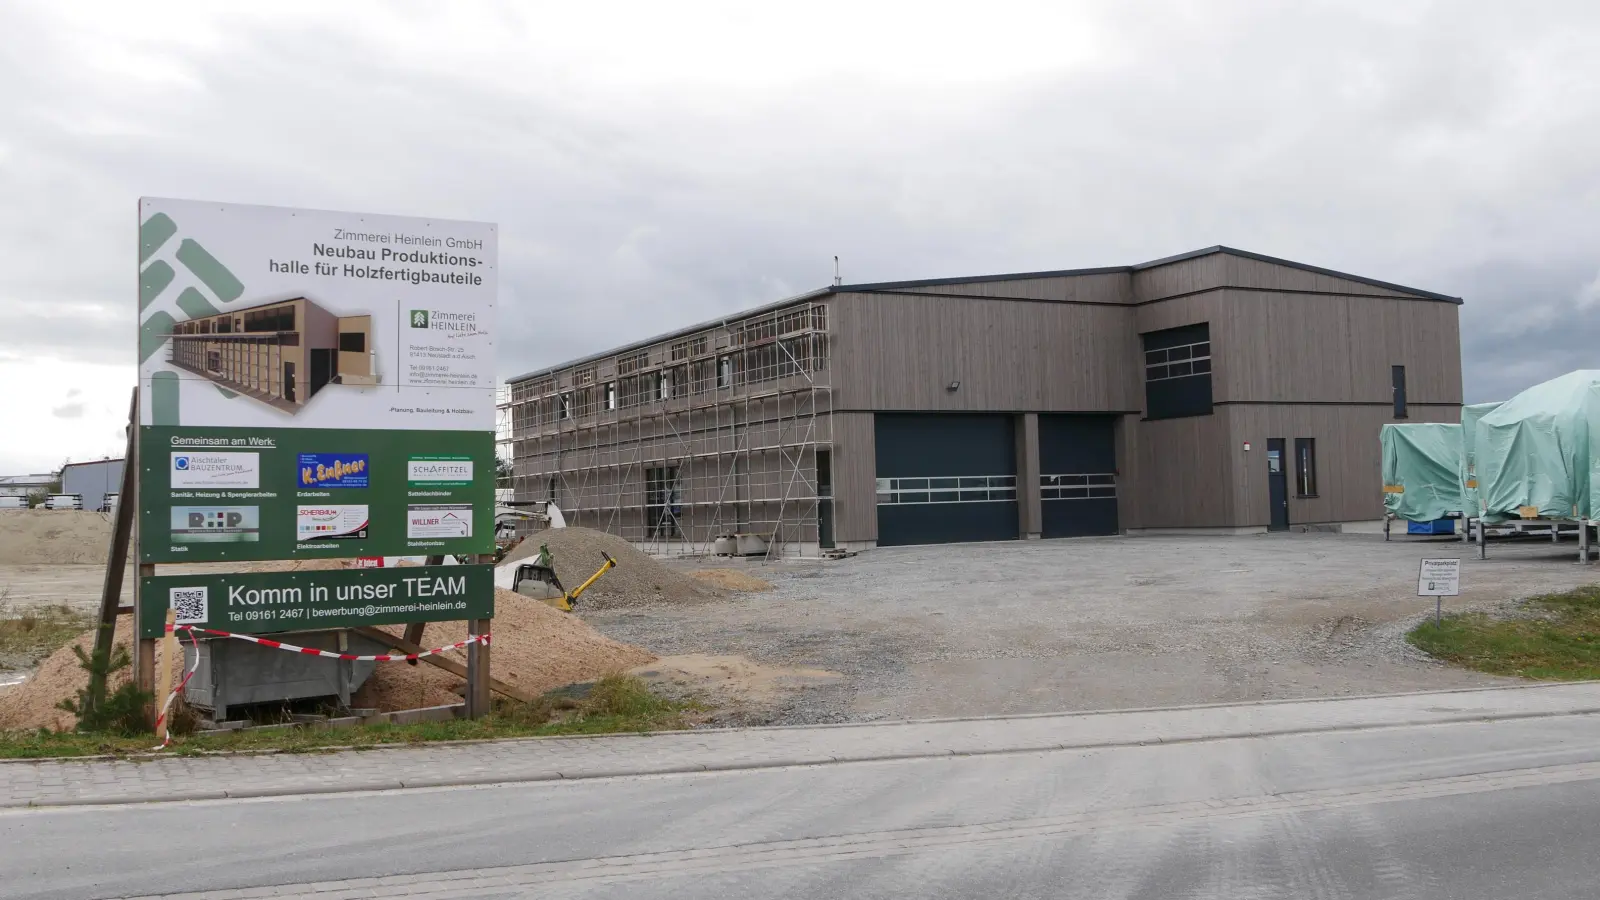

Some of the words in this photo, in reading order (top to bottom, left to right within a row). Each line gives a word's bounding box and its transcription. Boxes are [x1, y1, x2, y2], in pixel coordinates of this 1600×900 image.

[334, 228, 391, 244] Zimmerei
[394, 234, 442, 248] Heinlein
[446, 237, 483, 250] GmbH
[313, 243, 376, 260] Neubau
[381, 248, 483, 267] Produktions-
[269, 259, 309, 275] halle
[315, 262, 338, 277] für
[343, 264, 482, 286] Holzfertigbauteile
[431, 310, 476, 321] Zimmerei
[431, 322, 476, 331] HEINLEIN
[170, 435, 229, 446] Gemeinsam
[230, 438, 245, 446] am
[248, 437, 276, 447] Werk:
[190, 456, 228, 464] Aischtaler
[190, 464, 243, 472] BAUZENTRUM
[170, 491, 195, 499] Sanitär,
[195, 491, 221, 499] Heizung
[411, 518, 440, 526] WILLNER
[228, 585, 302, 606] Komm
[310, 582, 328, 602] in
[336, 582, 397, 600] unser
[402, 575, 466, 597] TEAM
[228, 611, 243, 621] Tel
[245, 610, 276, 620] 09161
[279, 608, 303, 619] 2467
[312, 600, 467, 618] bewerbung@zimmerei-heinlein.de
